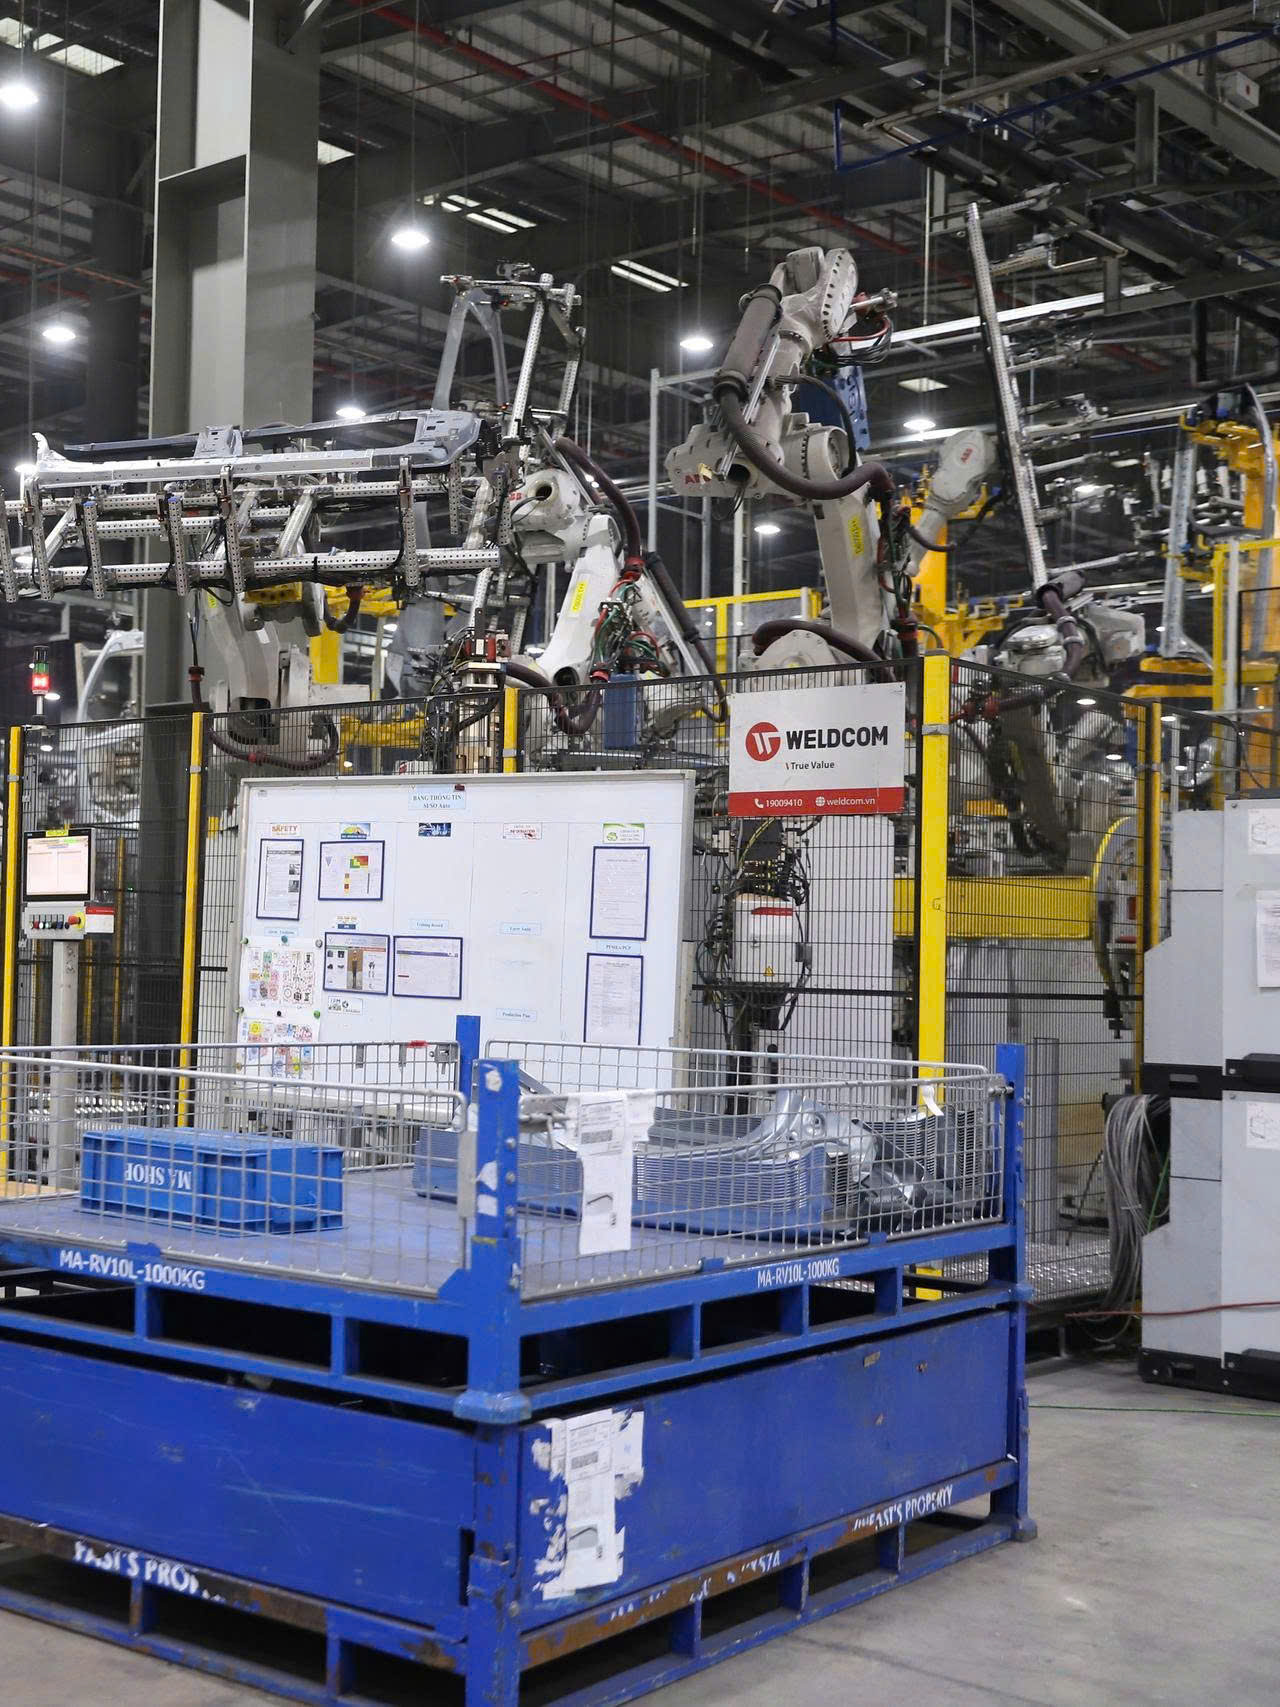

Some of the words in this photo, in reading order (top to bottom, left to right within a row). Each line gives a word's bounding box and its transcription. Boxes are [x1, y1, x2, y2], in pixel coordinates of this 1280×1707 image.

[786, 725, 888, 750] WELDCOM
[791, 761, 809, 770] True
[811, 760, 835, 769] Value
[766, 798, 802, 807] 19009410
[827, 797, 875, 806] weldcom.vn
[124, 1162, 165, 1186] SHOP
[168, 1168, 192, 1190] MA
[59, 1249, 205, 1290] MA-RV10L-1000KG
[757, 1257, 840, 1289] MA-RV10L-1000KG
